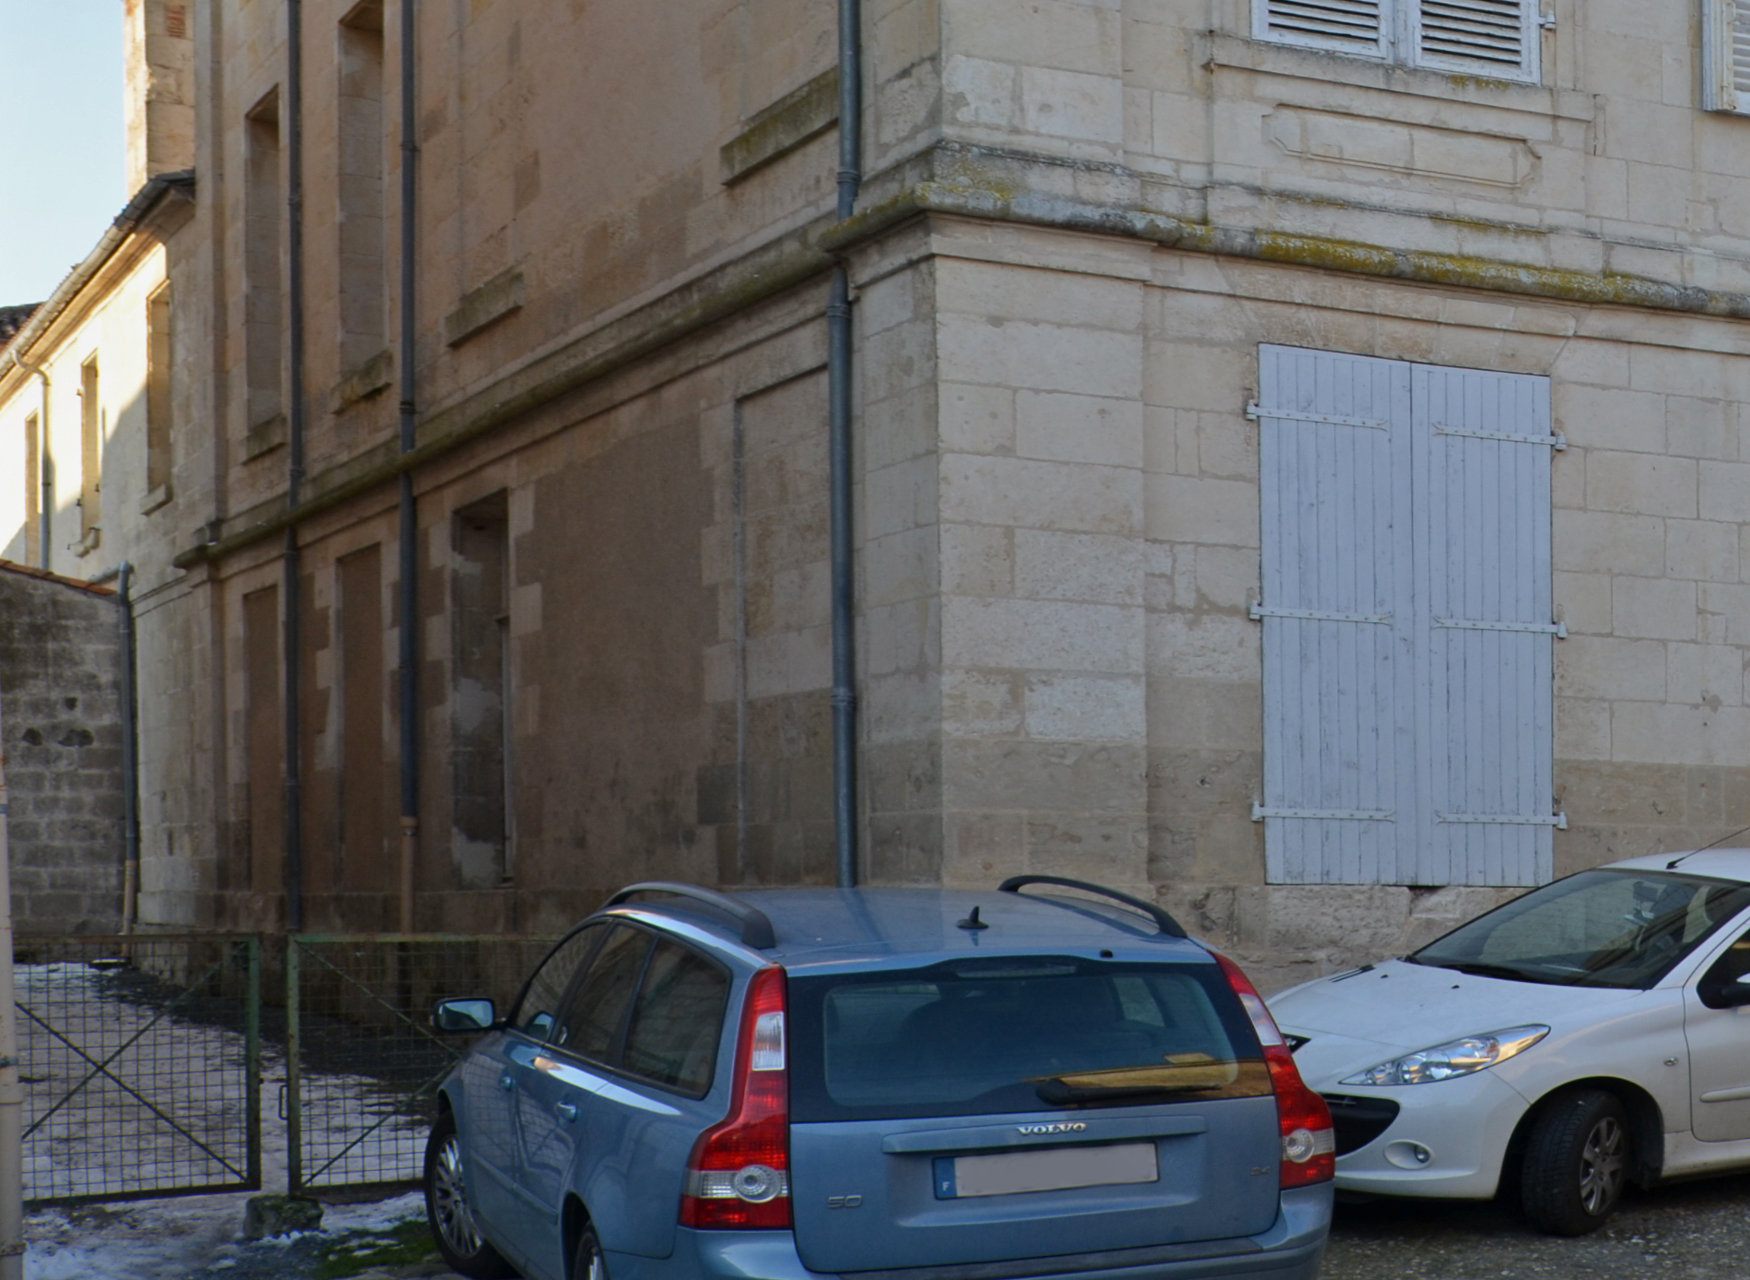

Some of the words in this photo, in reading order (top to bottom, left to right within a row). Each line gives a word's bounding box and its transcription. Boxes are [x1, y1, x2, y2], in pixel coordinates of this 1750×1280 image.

[1016, 1122, 1087, 1135] VOLVO
[942, 1181, 950, 1191] F
[827, 1194, 862, 1208] 50
